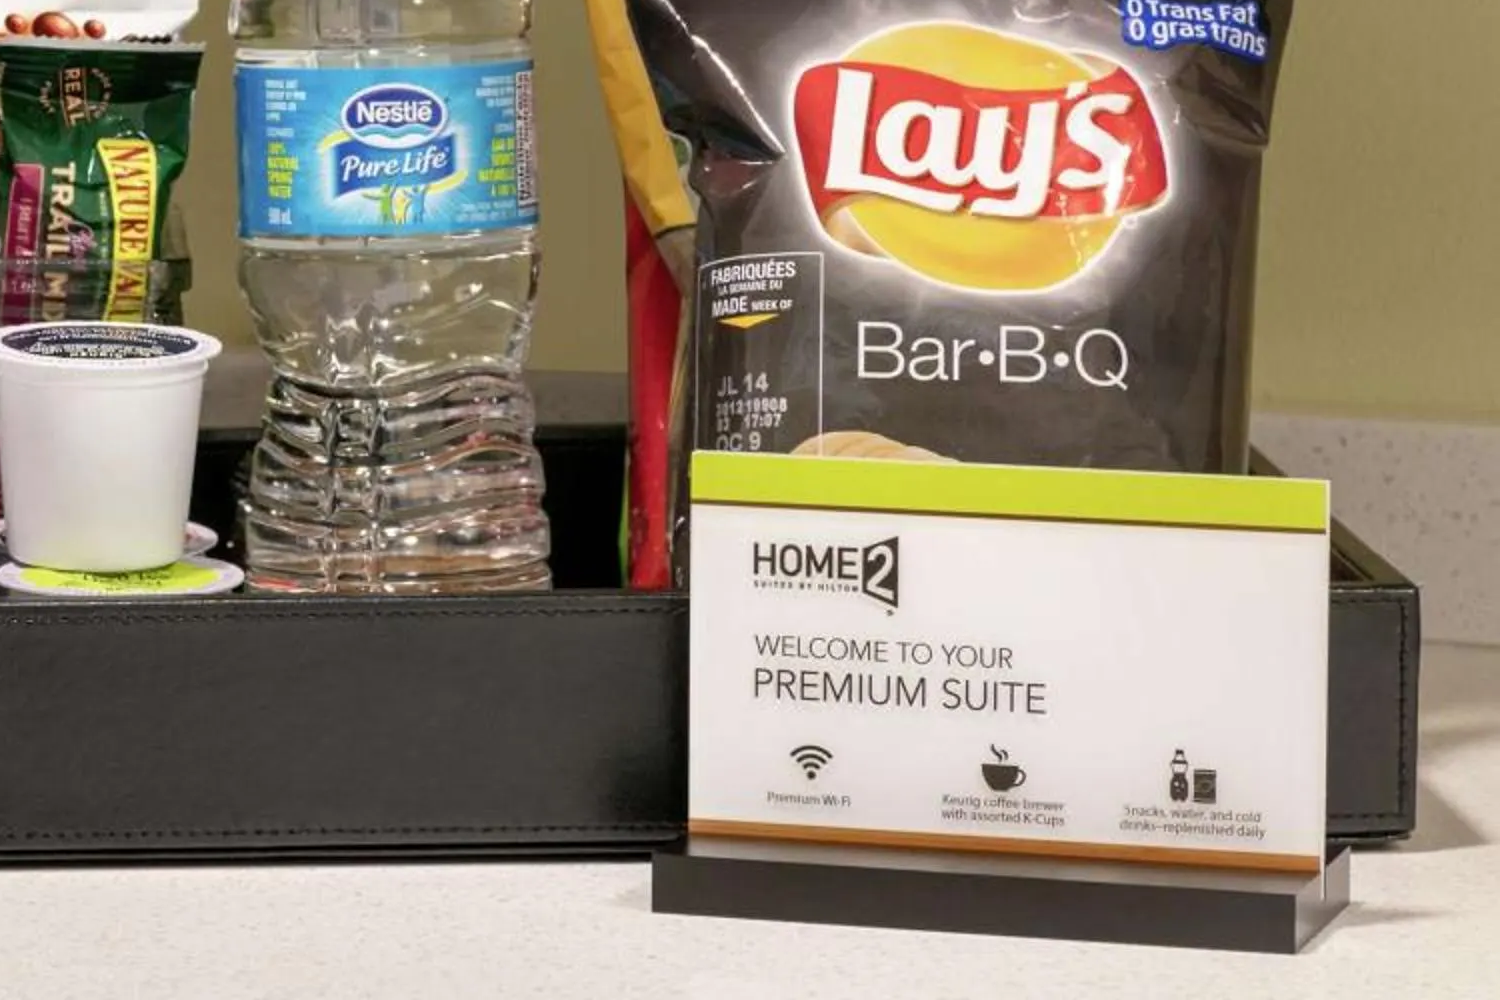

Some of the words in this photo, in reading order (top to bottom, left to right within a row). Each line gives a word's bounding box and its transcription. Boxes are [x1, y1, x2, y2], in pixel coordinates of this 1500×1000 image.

[1144, 0, 1215, 22] Trans
[1218, 1, 1257, 27] Fat
[1129, 18, 1145, 41] 0
[1152, 20, 1207, 45] gras
[1210, 22, 1267, 57] trans
[63, 67, 86, 127] REAL
[823, 66, 1133, 218] Lay's
[341, 155, 400, 183] Pure
[401, 144, 448, 175] Life
[45, 160, 77, 259] TRAIL
[106, 143, 150, 255] NATURE
[711, 258, 797, 286] FABRIQUÉES
[769, 280, 783, 290] DU
[108, 262, 149, 318] VALL
[712, 296, 748, 318] MADE
[751, 300, 778, 311] WEEK
[780, 299, 793, 310] OF
[717, 376, 739, 397] JL
[744, 372, 770, 392] 14
[749, 432, 761, 450] 9
[753, 580, 793, 589] SUITES
[817, 583, 859, 593] HILTON
[754, 634, 889, 662] WELCOME
[896, 641, 933, 665] TO
[941, 643, 1013, 669] YOUR
[754, 667, 927, 708] PREMIUM
[942, 678, 1047, 715] SUITE
[766, 791, 820, 805] Premium
[941, 794, 980, 809] Keurig
[983, 797, 1020, 810] coffee
[1023, 798, 1064, 811] brewer
[941, 808, 967, 820] with
[971, 810, 1020, 824] assorted
[1023, 811, 1065, 828] K-Cups
[1210, 809, 1233, 822] and
[1235, 811, 1262, 824] cold
[1237, 824, 1267, 841] daily
